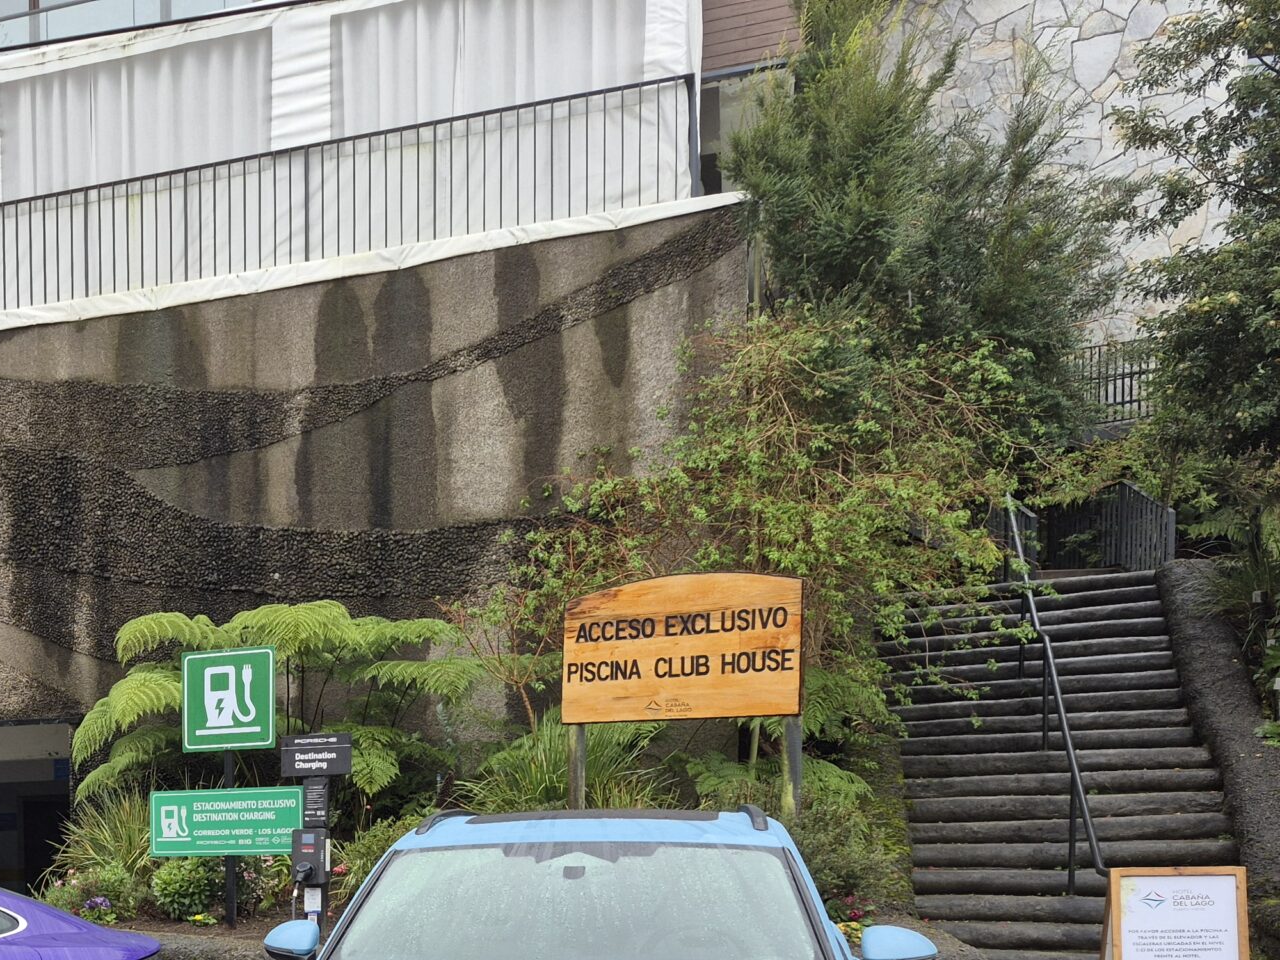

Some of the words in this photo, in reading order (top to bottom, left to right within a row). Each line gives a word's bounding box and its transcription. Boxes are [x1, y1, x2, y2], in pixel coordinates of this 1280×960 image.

[575, 618, 656, 643] ACCESO
[664, 606, 788, 637] EXCLUSIVO
[566, 659, 642, 683] PISCINA
[654, 655, 710, 678] CLUB
[721, 649, 795, 674] HOUSE
[295, 751, 337, 760] Destination
[295, 760, 327, 769] Charging
[193, 800, 257, 811] ESTACIONAMIENTO
[258, 799, 296, 808] EXCLUSIVO
[193, 812, 239, 822] DESTINATION
[240, 811, 276, 820] CHARGING
[1172, 893, 1211, 901] CABAÑA
